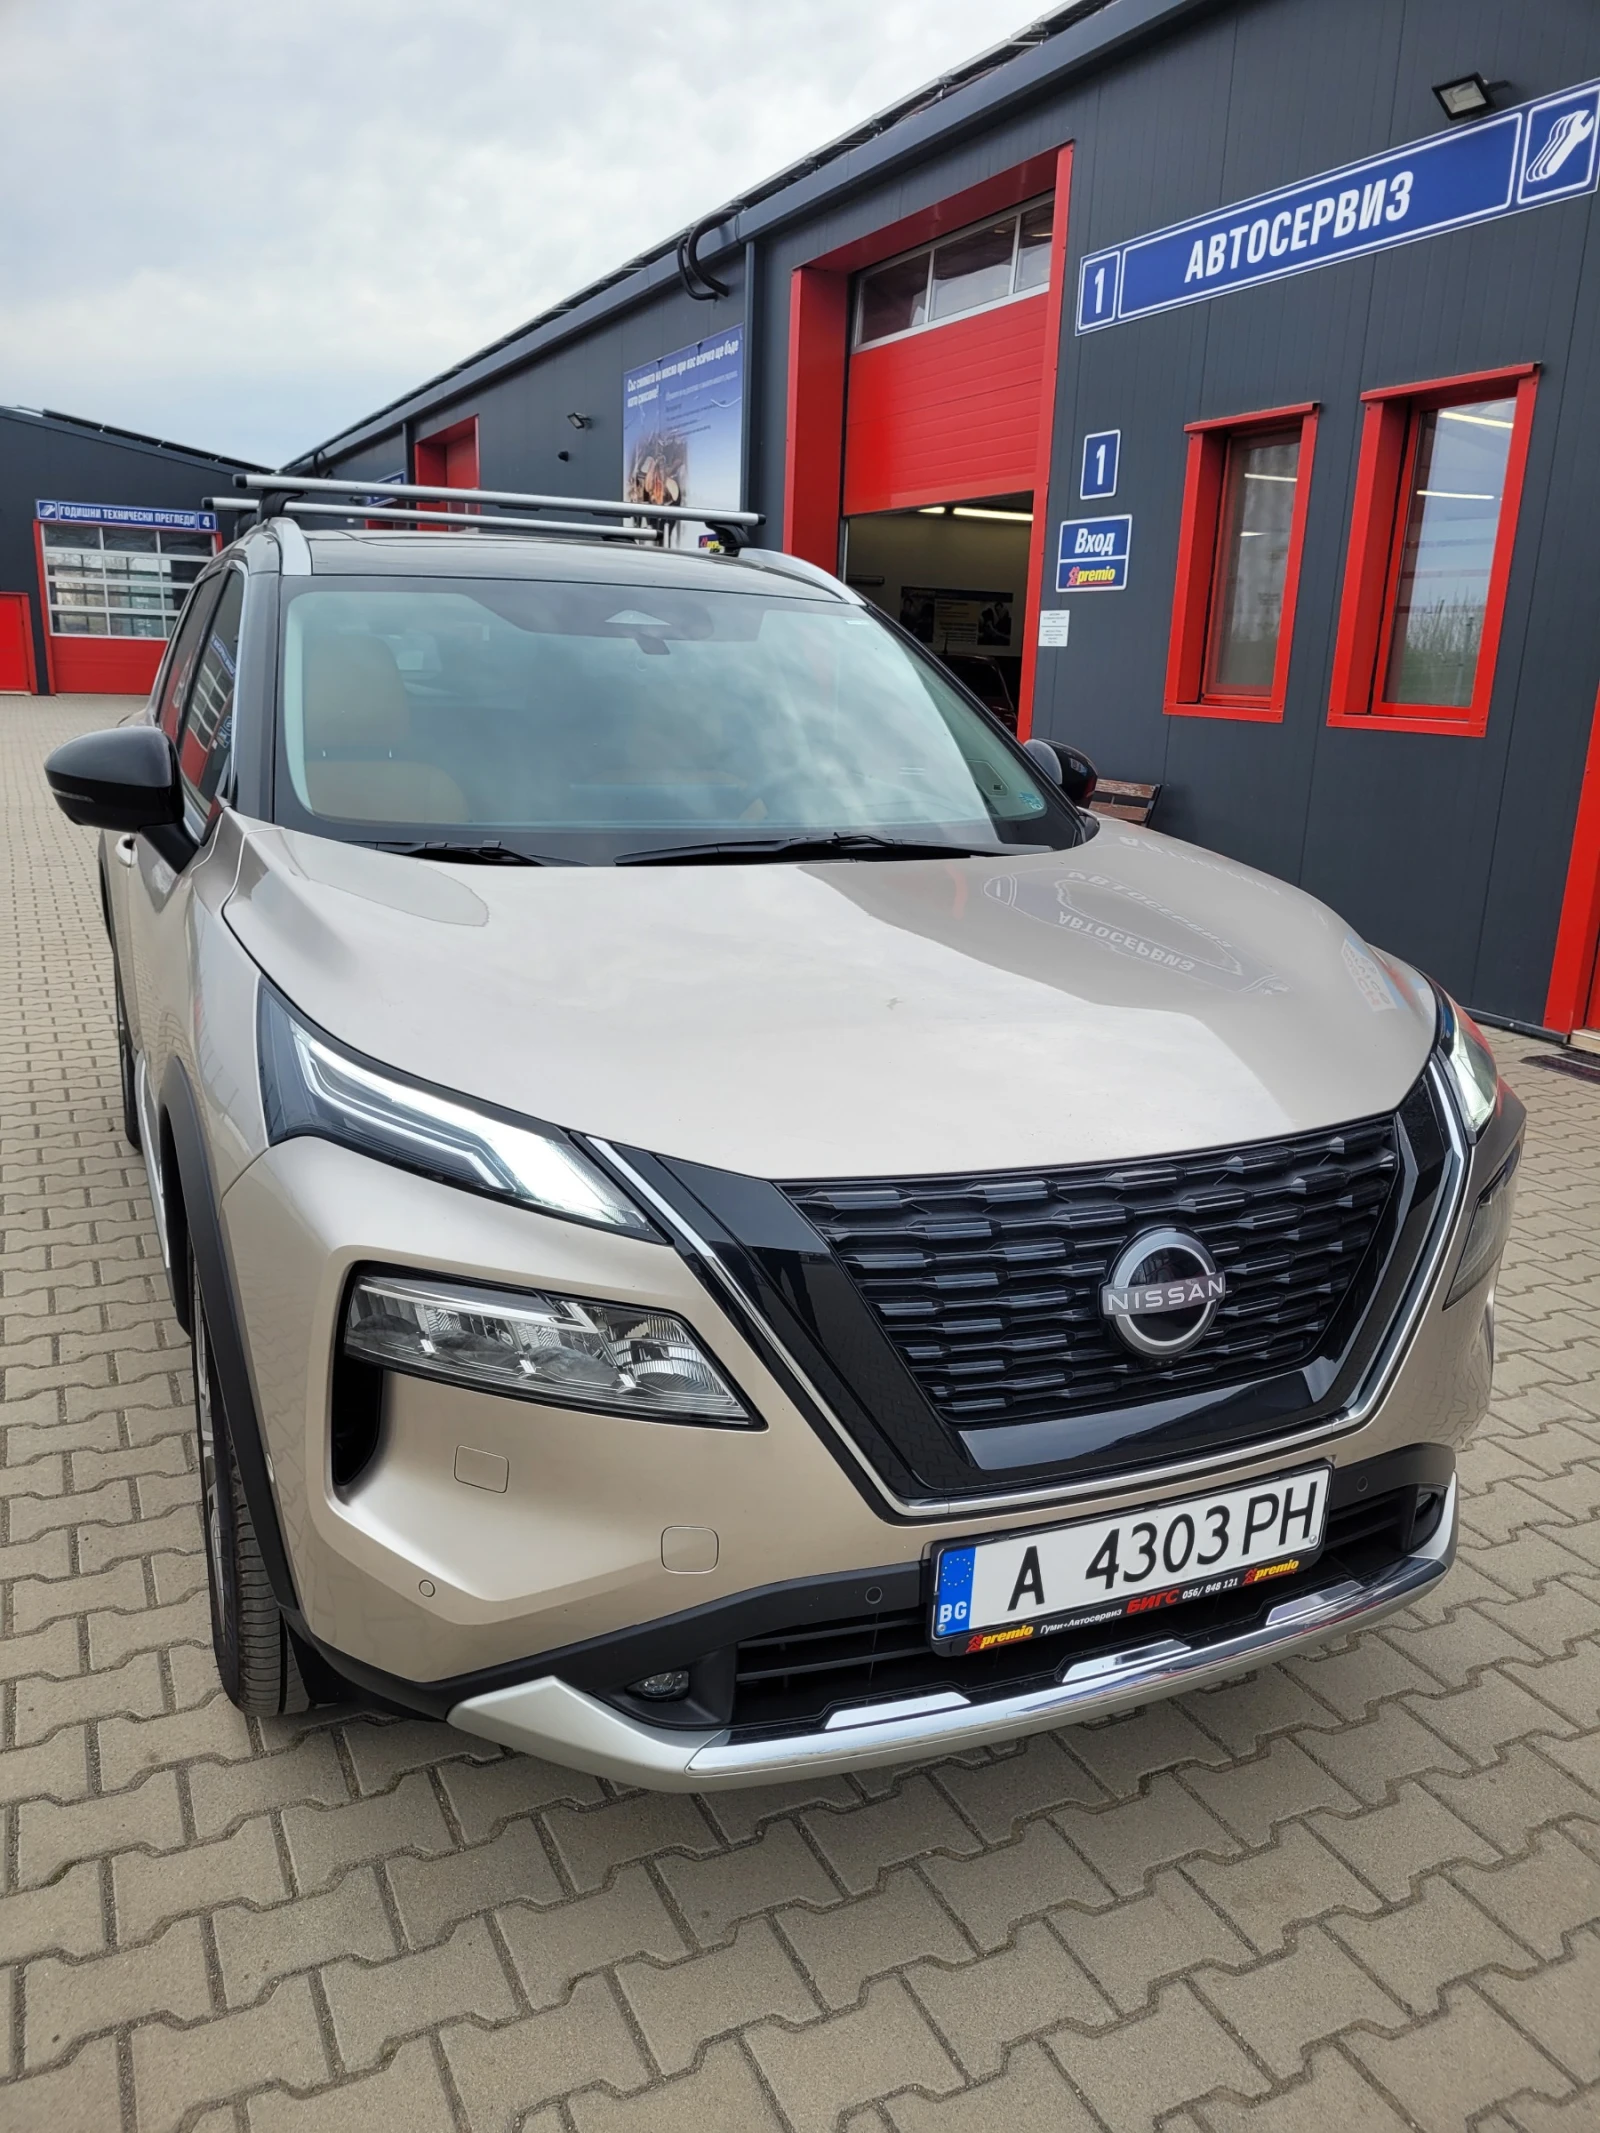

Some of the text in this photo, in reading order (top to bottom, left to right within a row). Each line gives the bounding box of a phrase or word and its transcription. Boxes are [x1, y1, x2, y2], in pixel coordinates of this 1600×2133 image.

[1093, 170, 1414, 315] 1 АВТОСЕРВИЗ
[1095, 443, 1106, 486] 1
[60, 507, 210, 528] ГОДИШНИ ТЕХНИЧЕСКИ ПРЕГЛЕДИ 4
[1074, 528, 1116, 556] Вход
[1077, 566, 1116, 586] premio
[1108, 1277, 1223, 1311] NISSAN
[1254, 1559, 1300, 1582] premio
[1126, 1588, 1180, 1614] БИГС
[1205, 1581, 1221, 1594] 848
[1222, 1577, 1239, 1589] 121
[939, 1601, 968, 1624] BG
[980, 1624, 1034, 1649] premio
